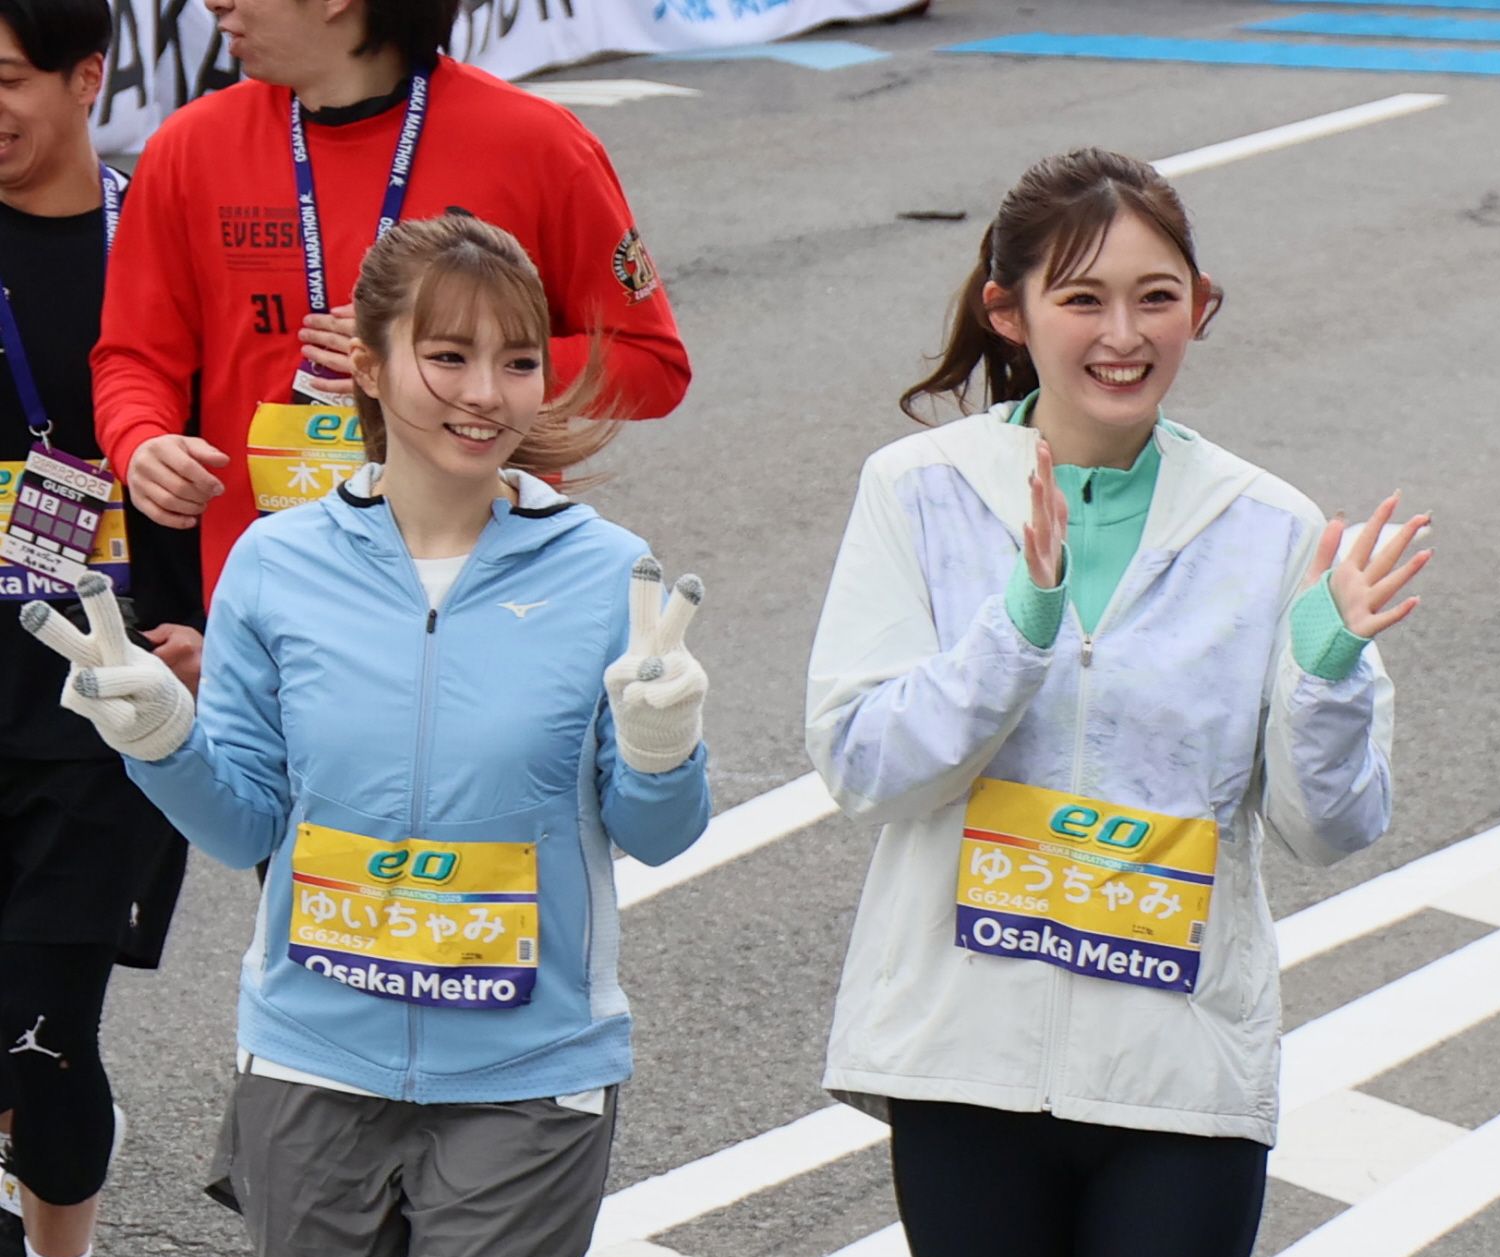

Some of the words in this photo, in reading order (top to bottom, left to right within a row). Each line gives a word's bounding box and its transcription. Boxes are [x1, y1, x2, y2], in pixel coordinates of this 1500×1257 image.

[409, 76, 427, 111] OSAKA
[391, 111, 422, 175] MARATHON
[221, 221, 303, 248] EVESS
[301, 205, 322, 269] MARATHON
[307, 270, 326, 310] OSAKA
[250, 294, 289, 334] 31
[42, 479, 86, 502] GUEST
[64, 469, 108, 497] 2025
[43, 499, 54, 512] 2
[82, 515, 92, 526] 4
[1049, 804, 1151, 849] eo
[367, 849, 457, 881] eo
[970, 846, 1183, 920] ゆうちゃみ
[301, 889, 507, 943] ゆいちゃみ
[967, 886, 1050, 913] G62456
[298, 925, 377, 950] G62457
[972, 916, 1073, 963] Osaka
[1075, 938, 1181, 983] Metro
[304, 955, 406, 995] Osaka
[411, 970, 516, 1001] Metro
